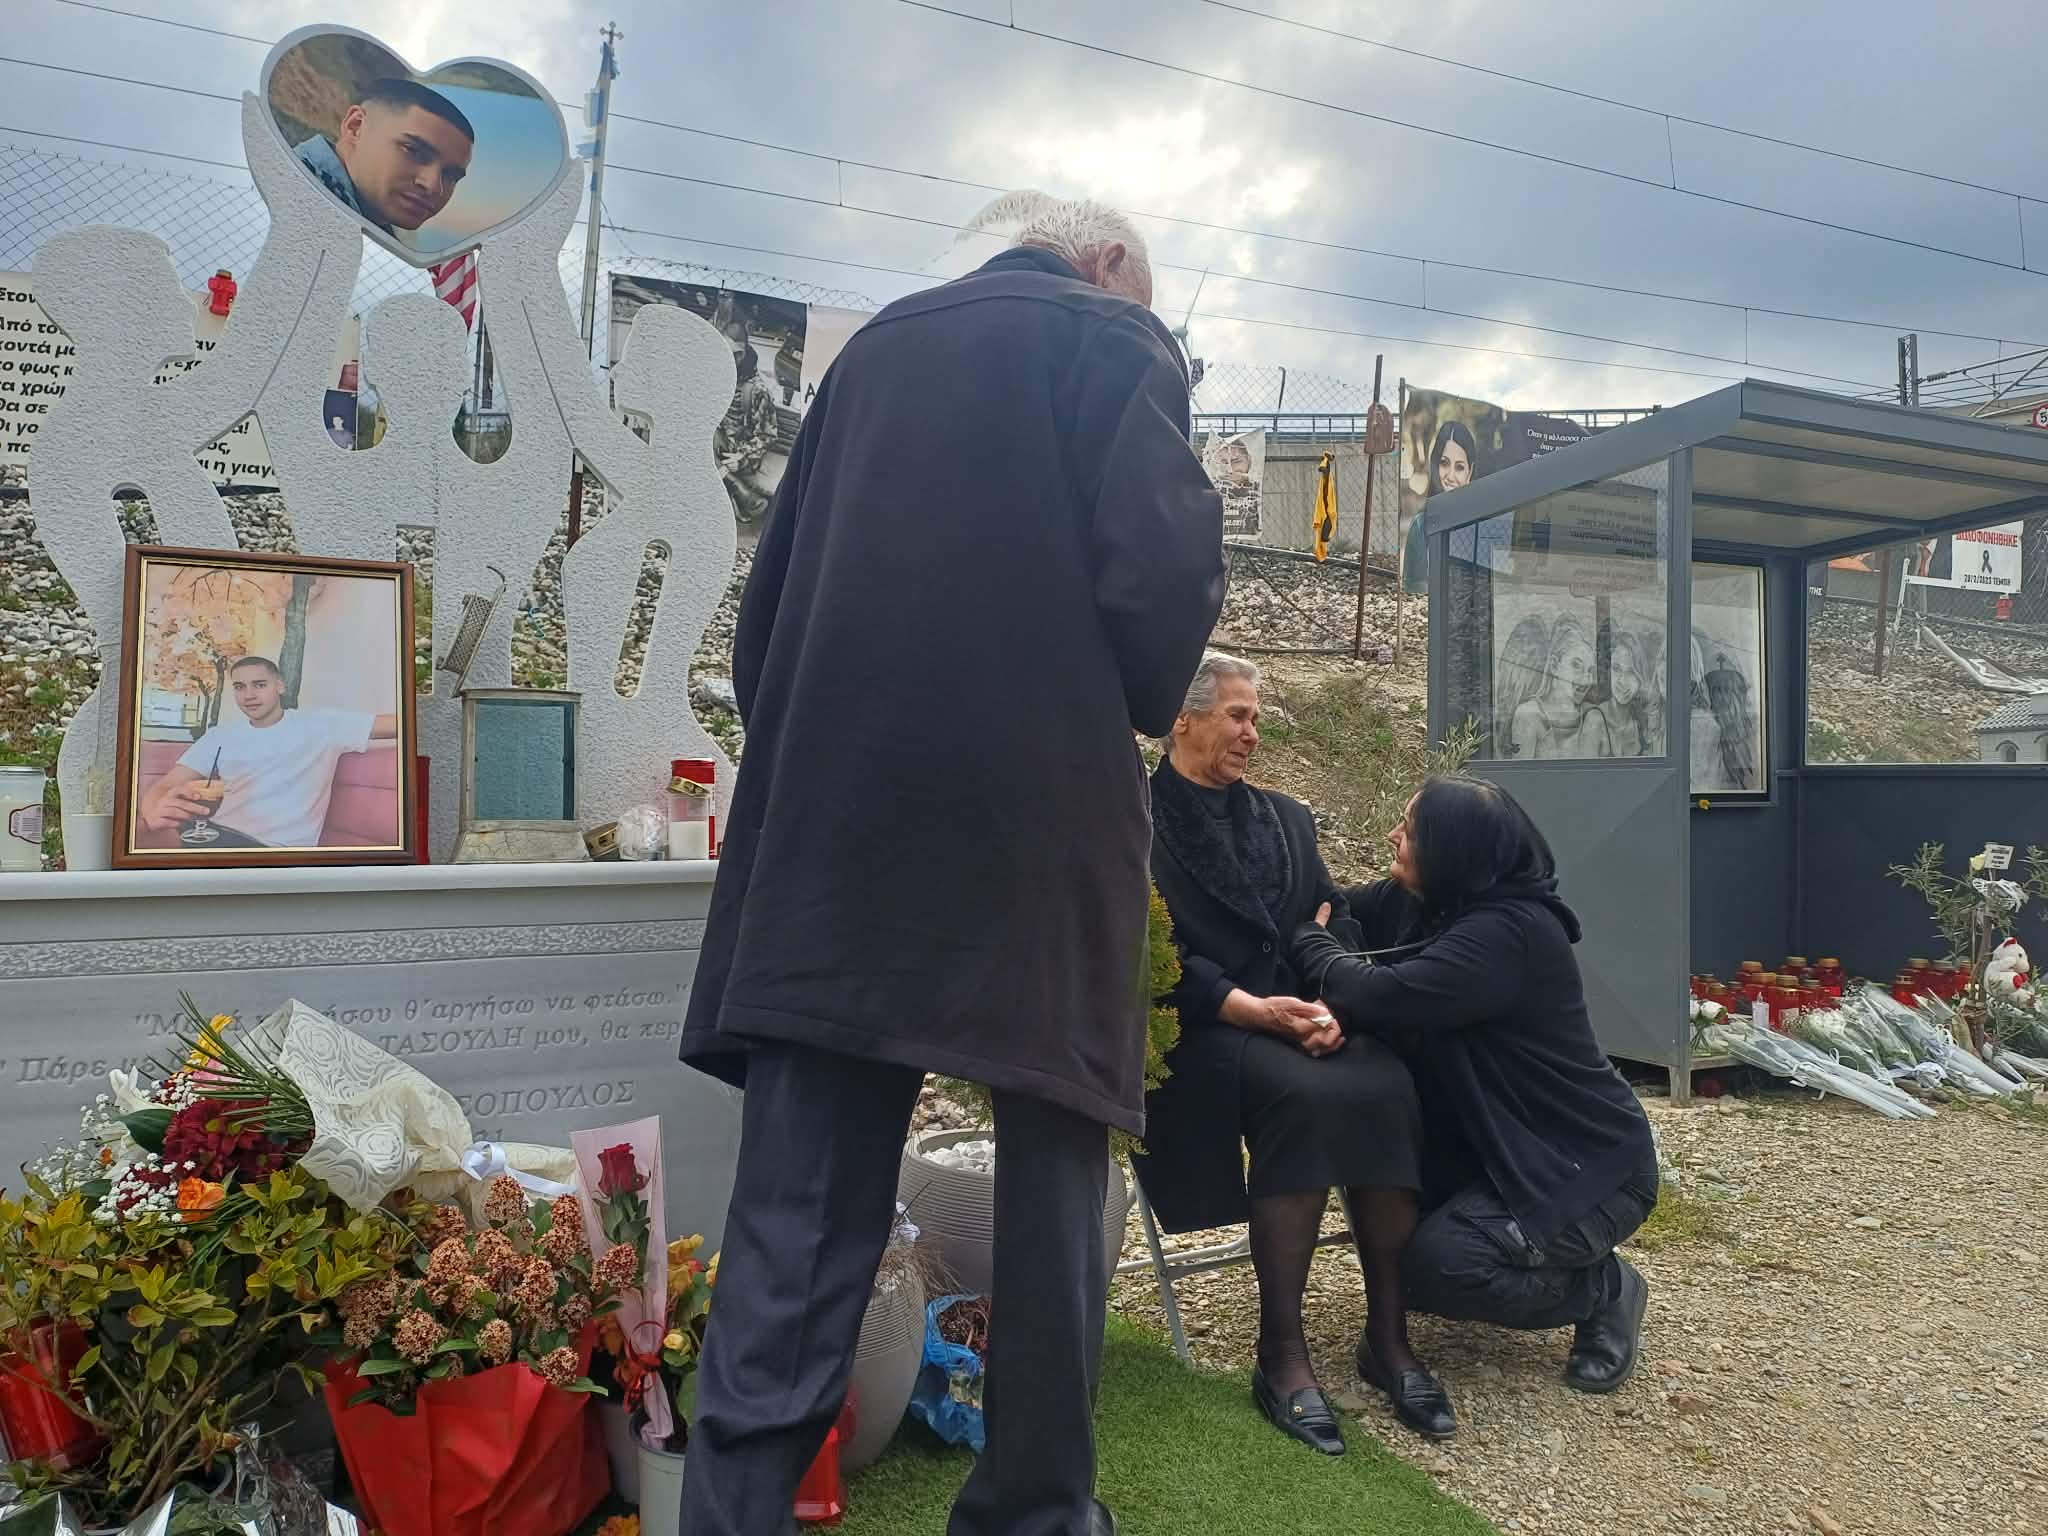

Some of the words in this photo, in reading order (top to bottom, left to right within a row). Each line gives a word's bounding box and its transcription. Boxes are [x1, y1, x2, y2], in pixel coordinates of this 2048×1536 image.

[38, 323, 64, 335] το
[19, 362, 60, 378] φως
[0, 381, 15, 391] α
[25, 403, 48, 414] σε
[548, 995, 577, 1012] να
[600, 1020, 630, 1041] θα
